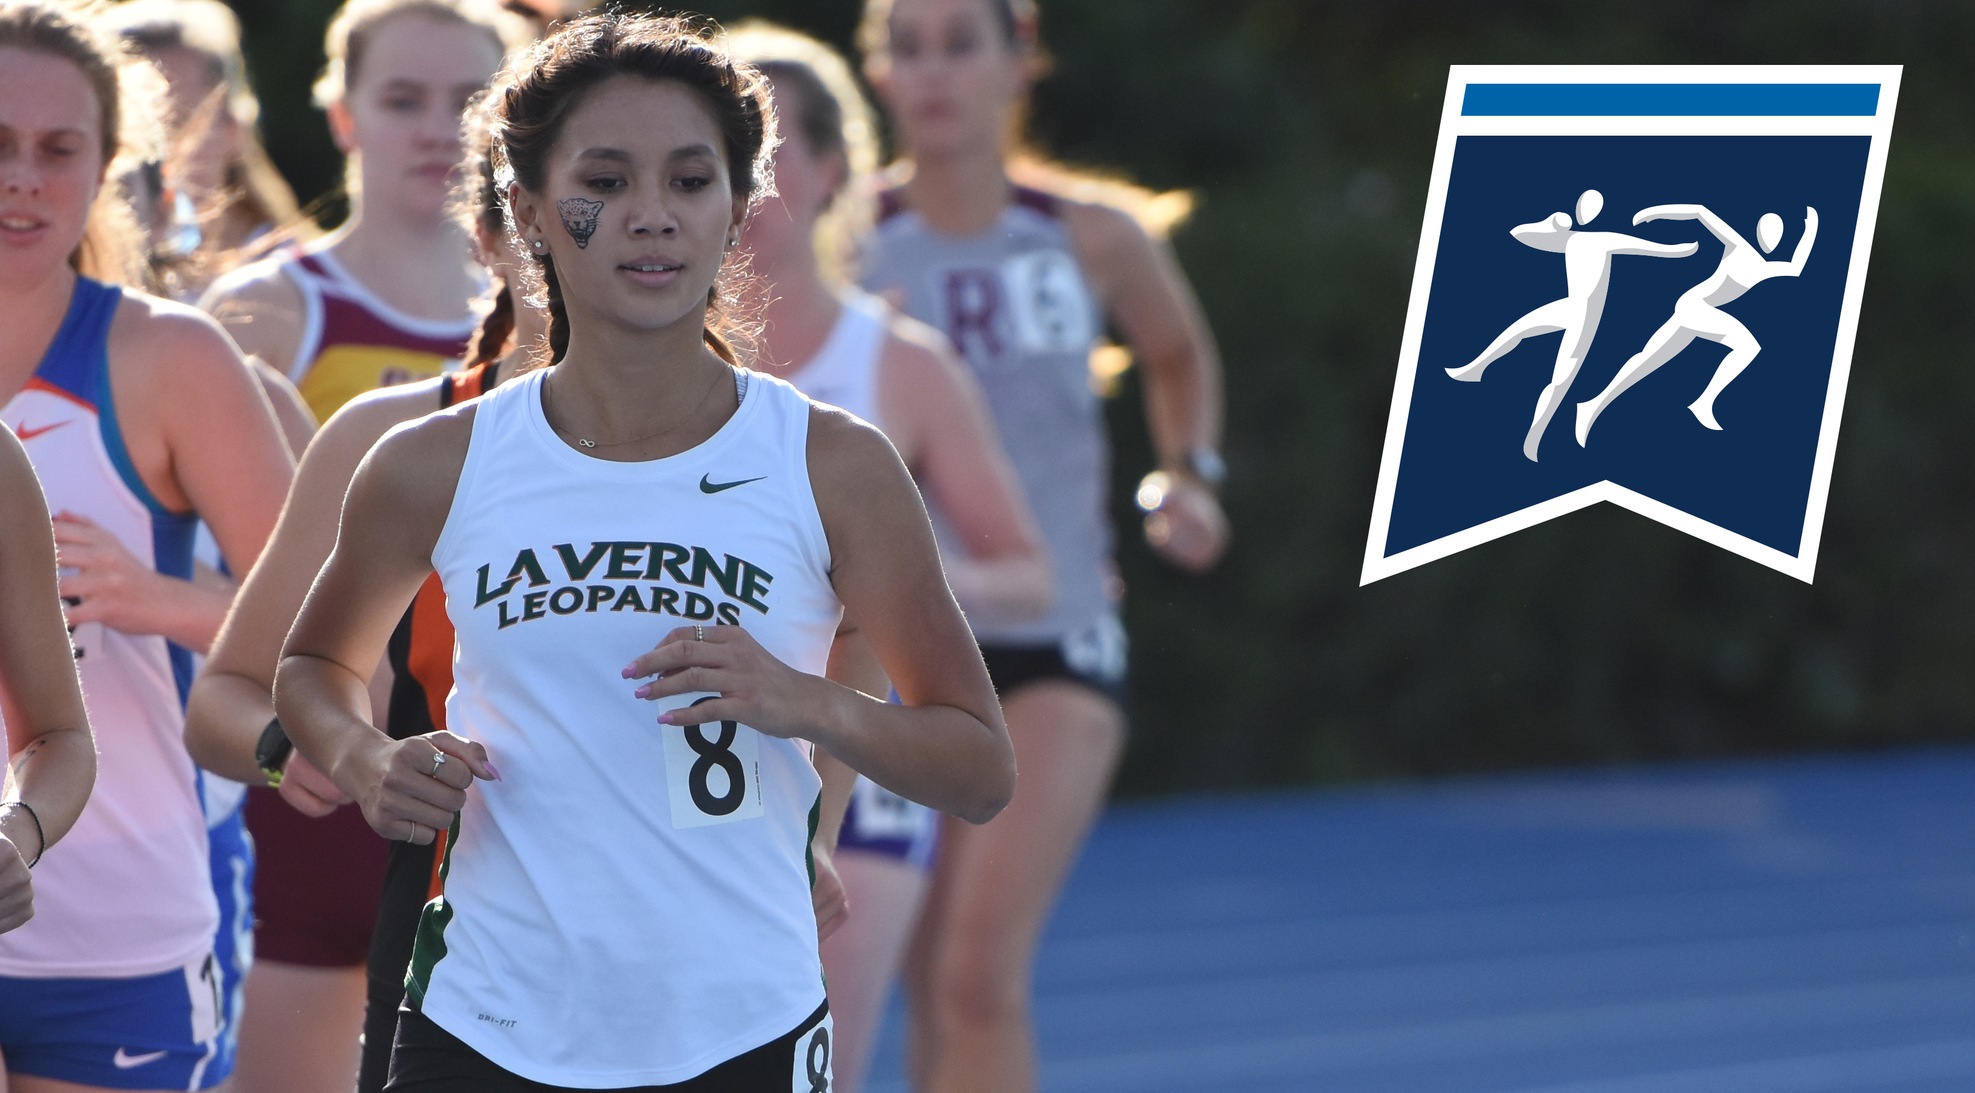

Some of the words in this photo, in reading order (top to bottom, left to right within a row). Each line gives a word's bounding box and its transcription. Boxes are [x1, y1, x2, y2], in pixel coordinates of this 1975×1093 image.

[473, 548, 551, 610] LA
[552, 541, 774, 616] VERNE
[497, 585, 741, 630] LEOPARDS
[683, 695, 746, 817] 8
[477, 1013, 517, 1028] DRI-FIT
